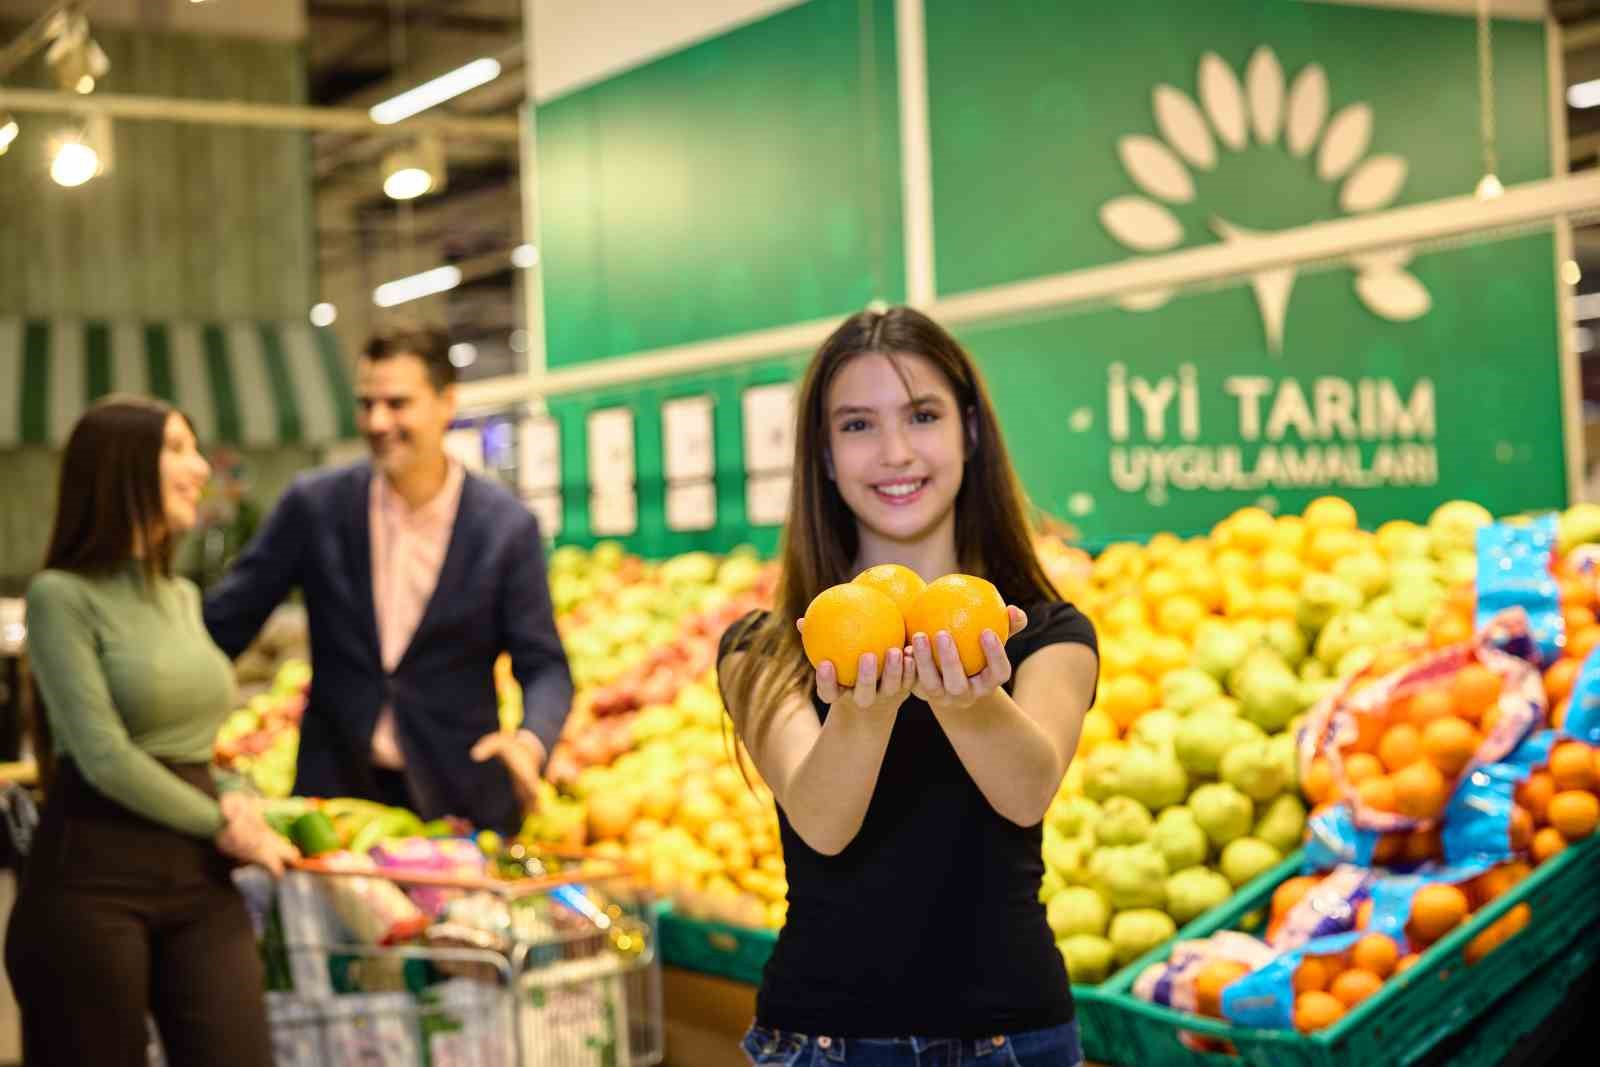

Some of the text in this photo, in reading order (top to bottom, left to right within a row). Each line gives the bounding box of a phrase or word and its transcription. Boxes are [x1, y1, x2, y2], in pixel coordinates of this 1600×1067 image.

[1109, 363, 1435, 440] İYİ TARIM
[1111, 444, 1437, 497] UYGULAMALARI
